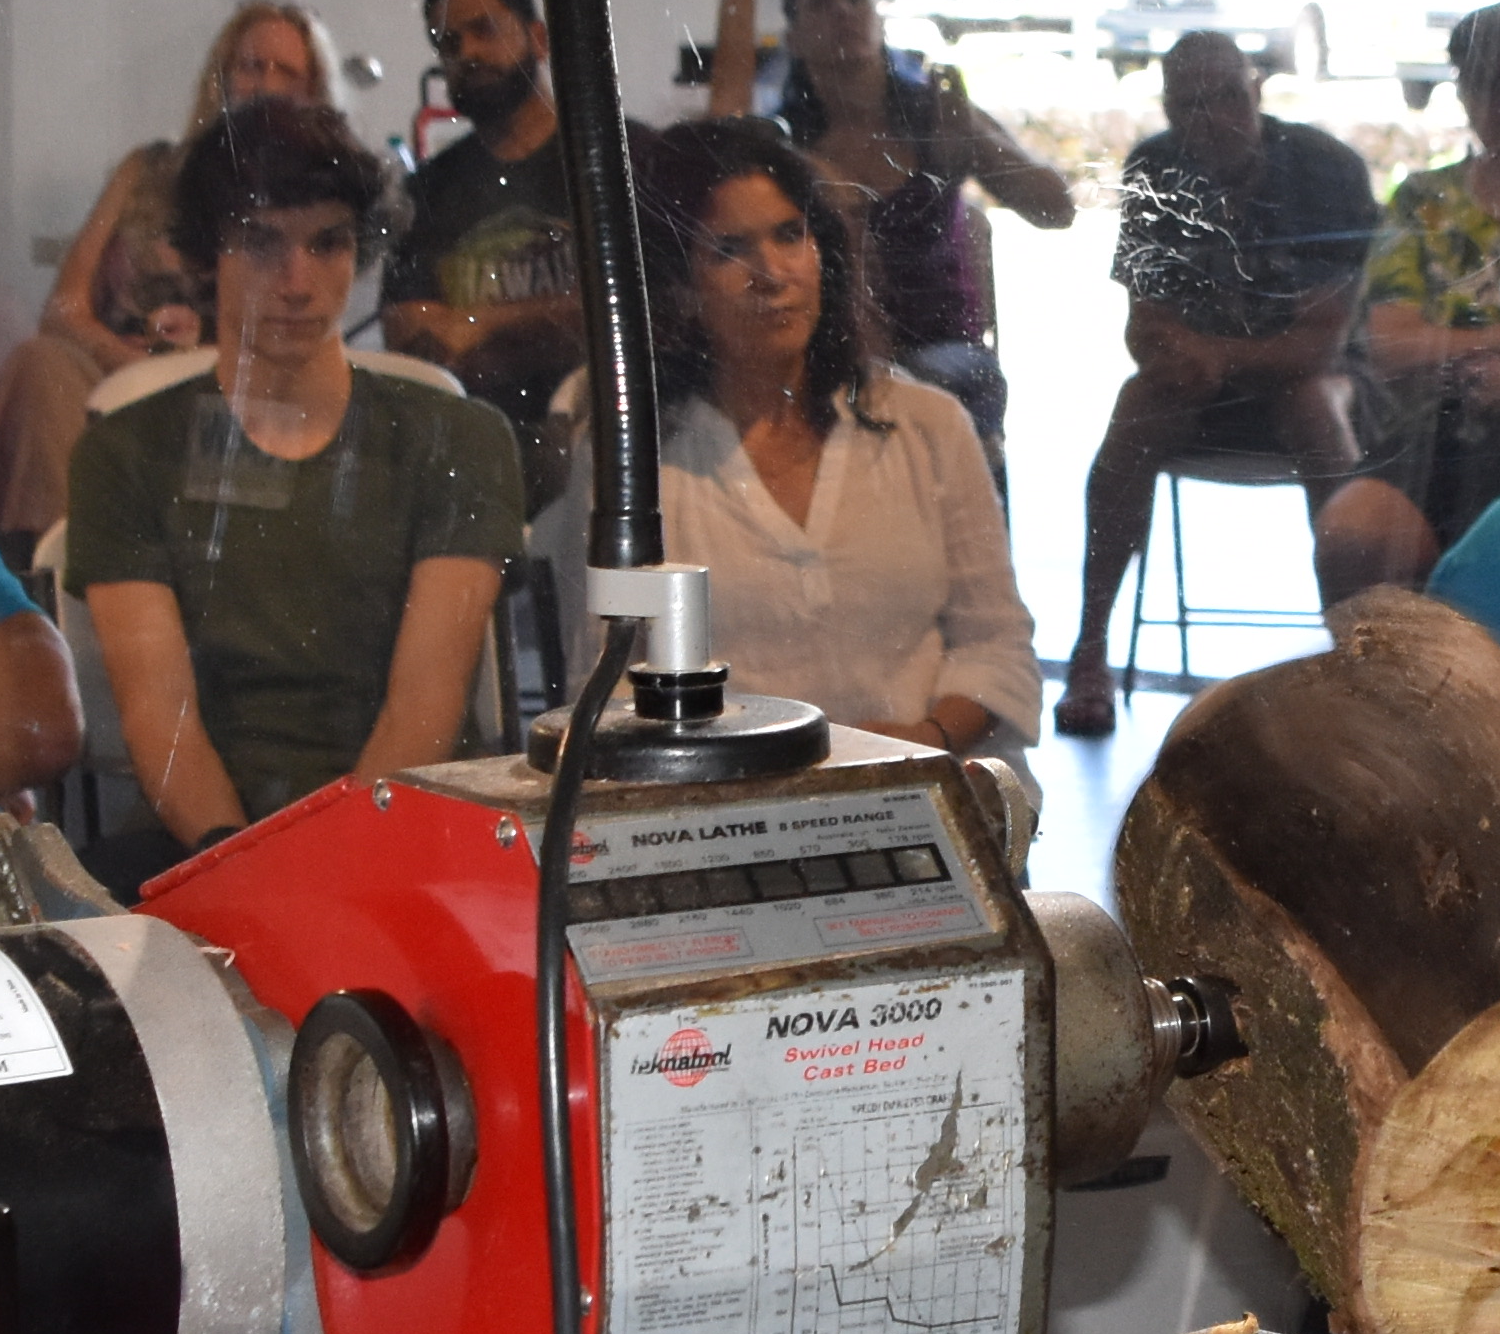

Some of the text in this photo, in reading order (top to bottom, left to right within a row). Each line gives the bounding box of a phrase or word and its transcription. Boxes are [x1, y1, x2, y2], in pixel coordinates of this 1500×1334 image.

[631, 830, 694, 848] NOVA
[699, 821, 768, 841] LATHE
[779, 823, 788, 832] 8
[792, 817, 838, 830] SPEED
[842, 810, 895, 825] RANGE
[765, 996, 942, 1040] NOVA 3000
[784, 1031, 925, 1063] Swivel Head
[803, 1055, 908, 1082] Cast Bed
